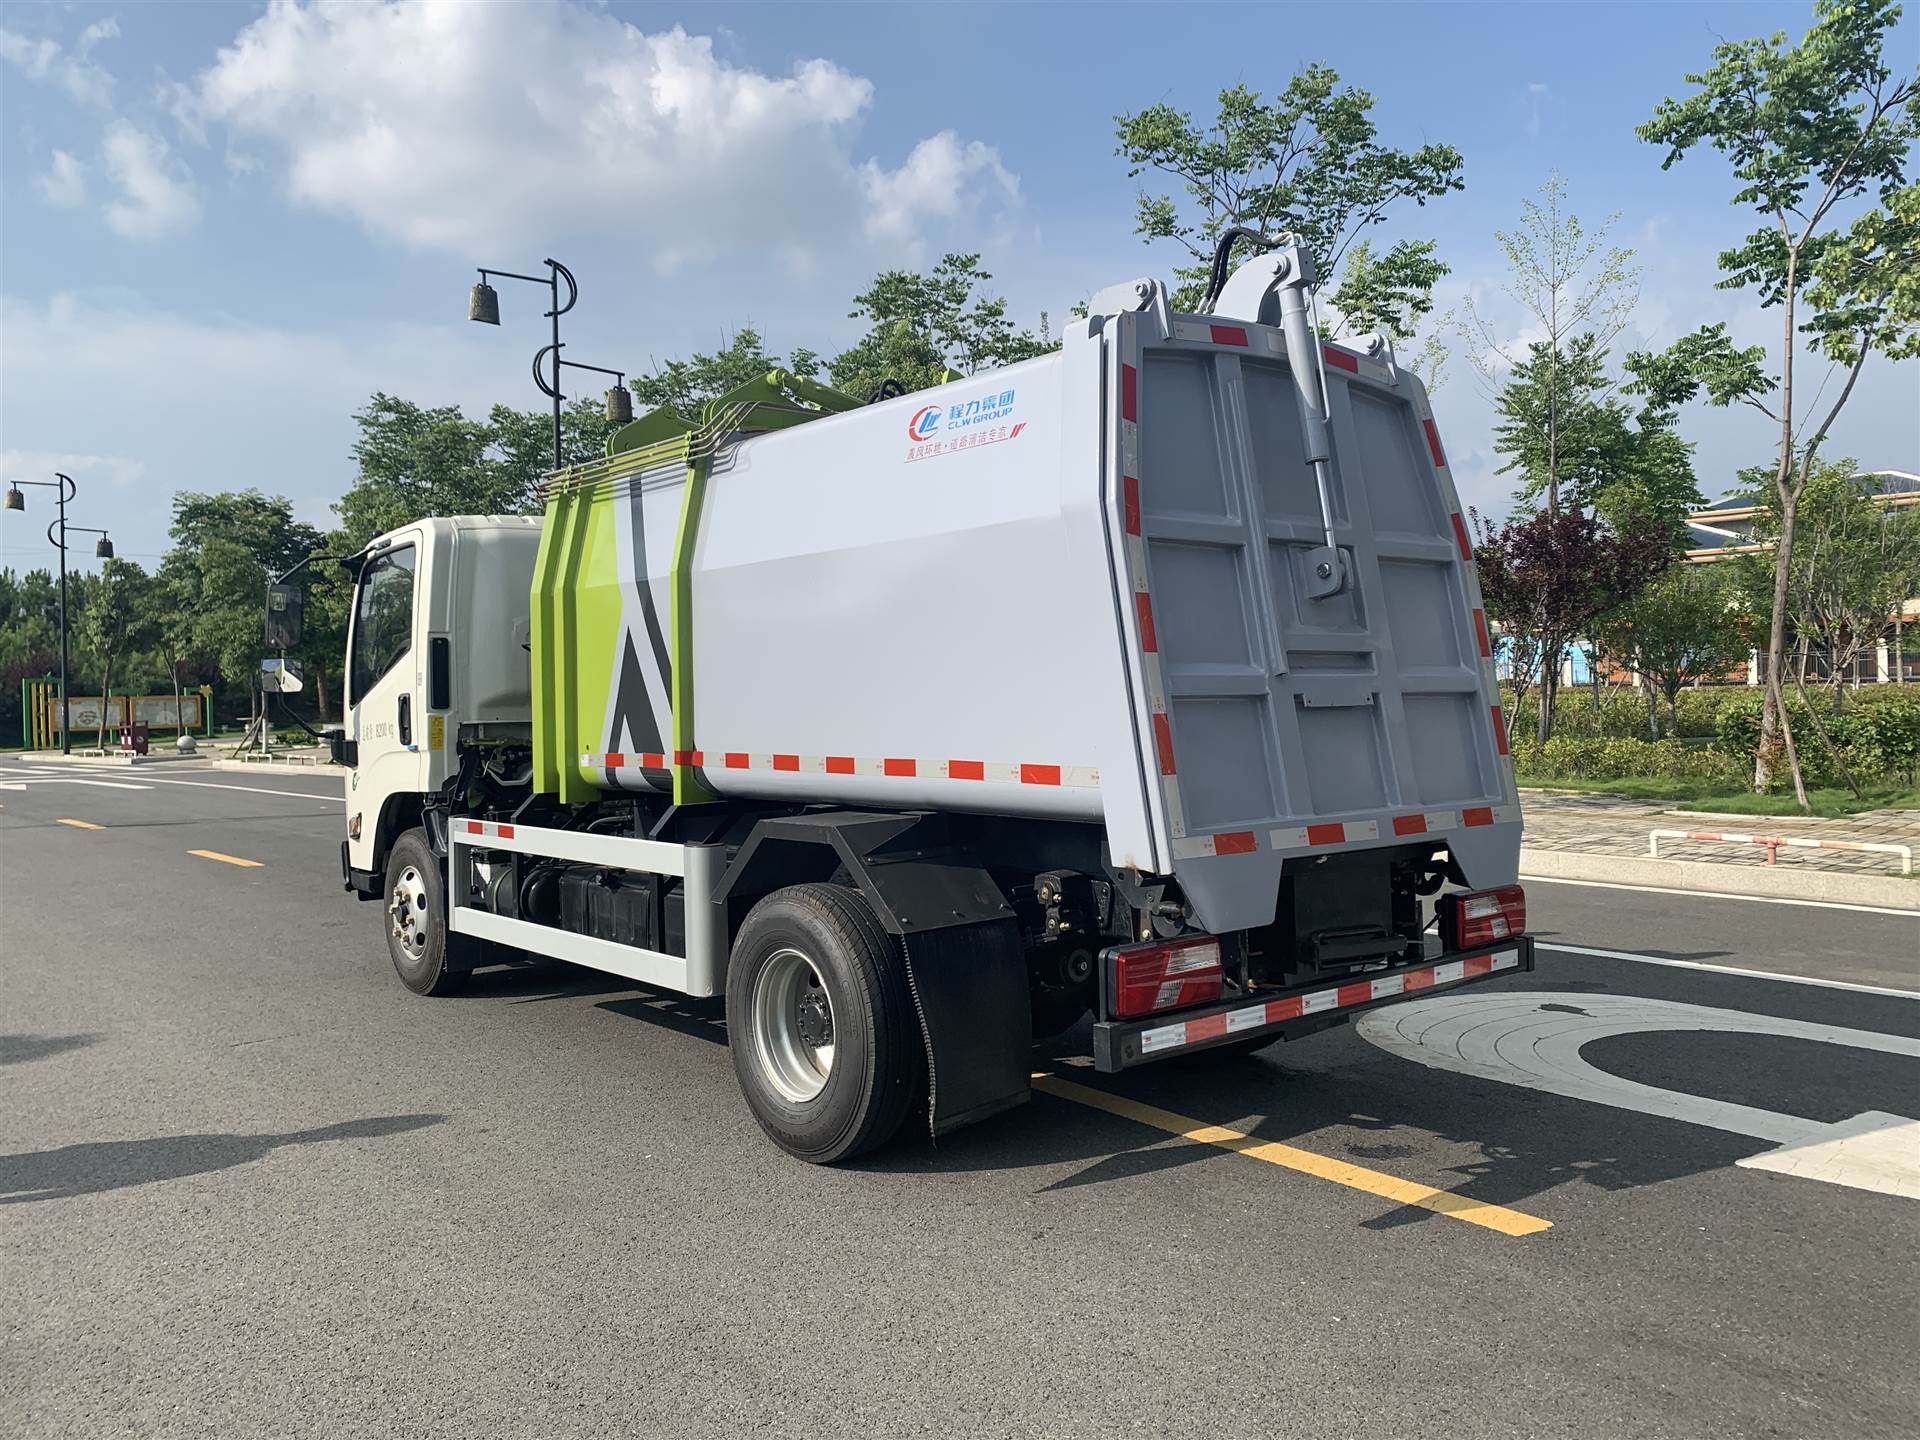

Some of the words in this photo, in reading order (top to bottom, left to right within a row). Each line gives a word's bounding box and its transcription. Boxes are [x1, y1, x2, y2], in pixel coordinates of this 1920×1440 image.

[949, 390, 1015, 420] 程力集团
[948, 418, 972, 430] CLW
[973, 407, 1013, 424] GROUP
